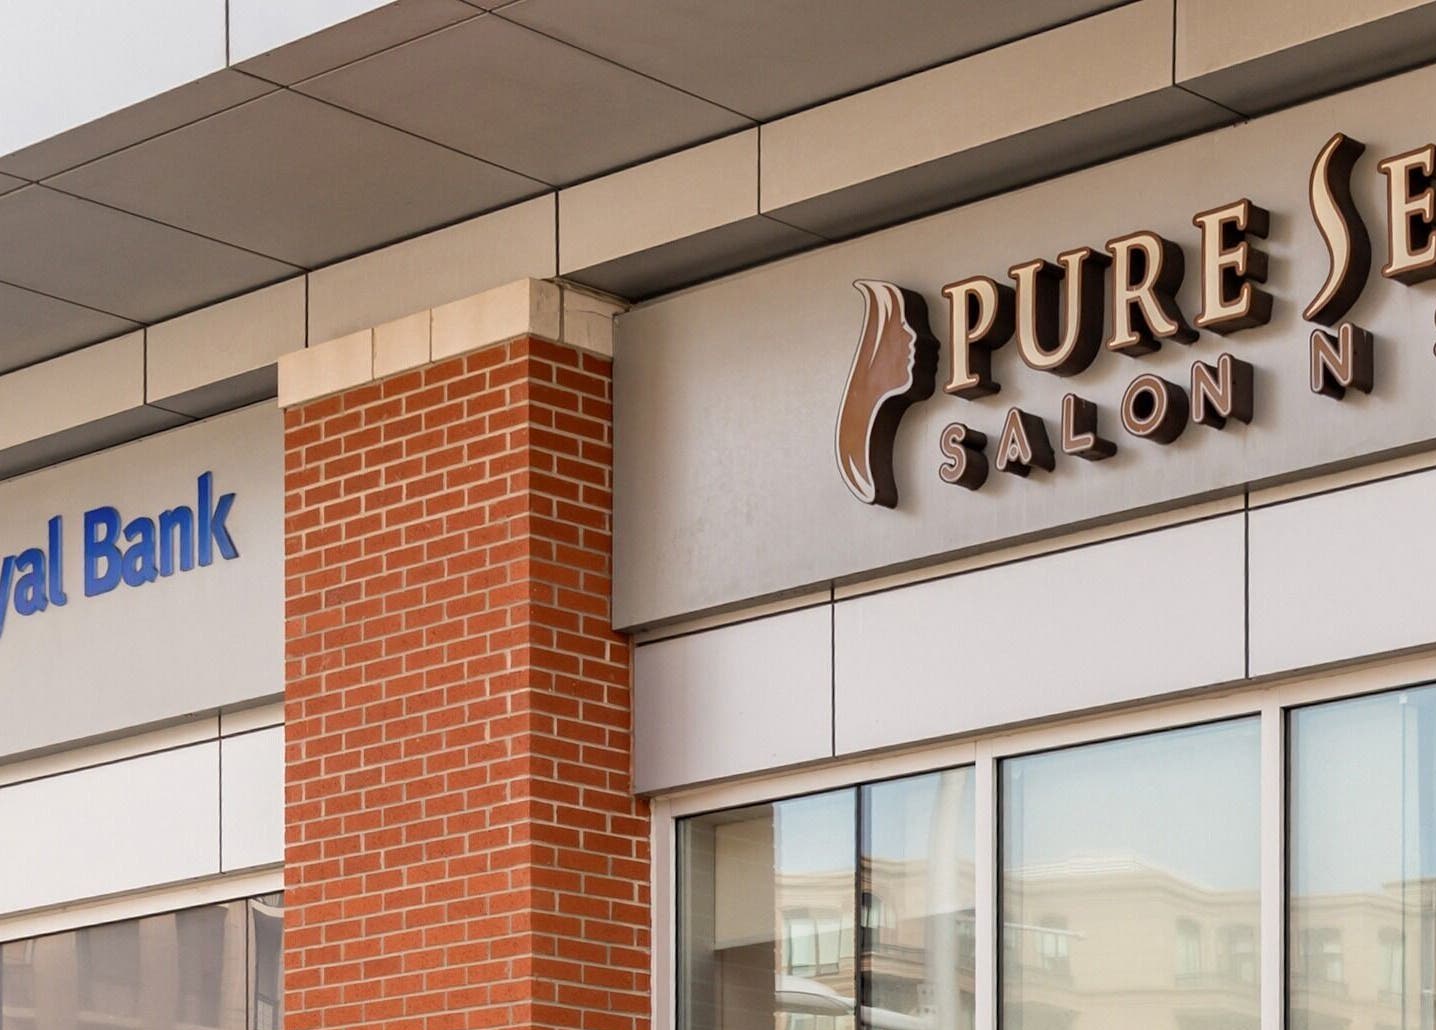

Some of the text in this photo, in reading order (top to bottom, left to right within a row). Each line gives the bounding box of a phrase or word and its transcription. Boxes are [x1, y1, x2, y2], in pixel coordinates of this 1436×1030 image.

[942, 199, 1274, 401] PURE
[938, 353, 1255, 491] SALON
[1310, 322, 1374, 400] N
[84, 471, 239, 598] Bank
